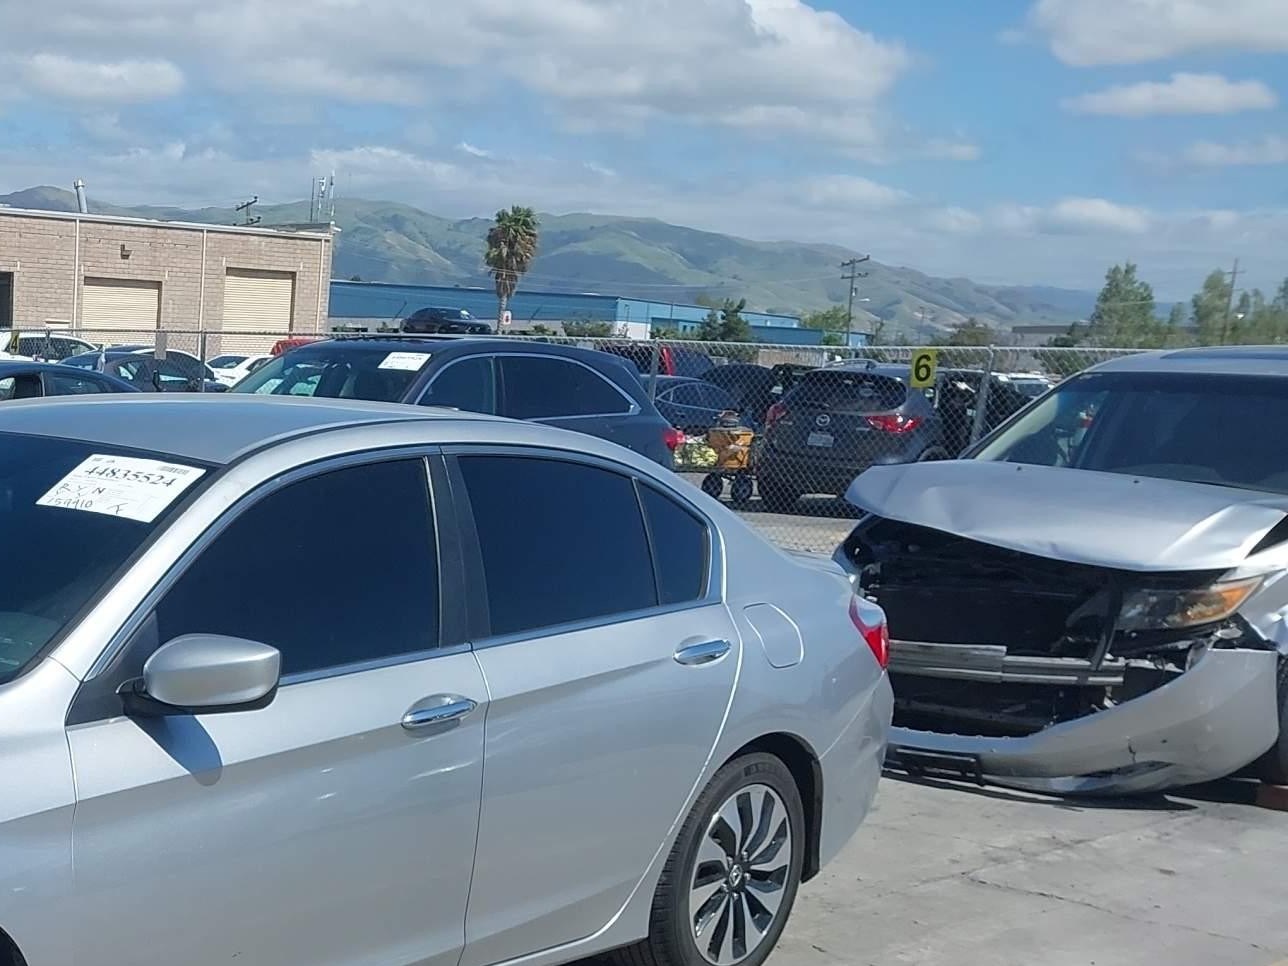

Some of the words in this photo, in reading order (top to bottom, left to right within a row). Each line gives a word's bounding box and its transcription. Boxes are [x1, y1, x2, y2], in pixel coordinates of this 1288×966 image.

[11, 334, 18, 352] 4
[914, 354, 931, 382] 6
[85, 466, 177, 487] 44835524
